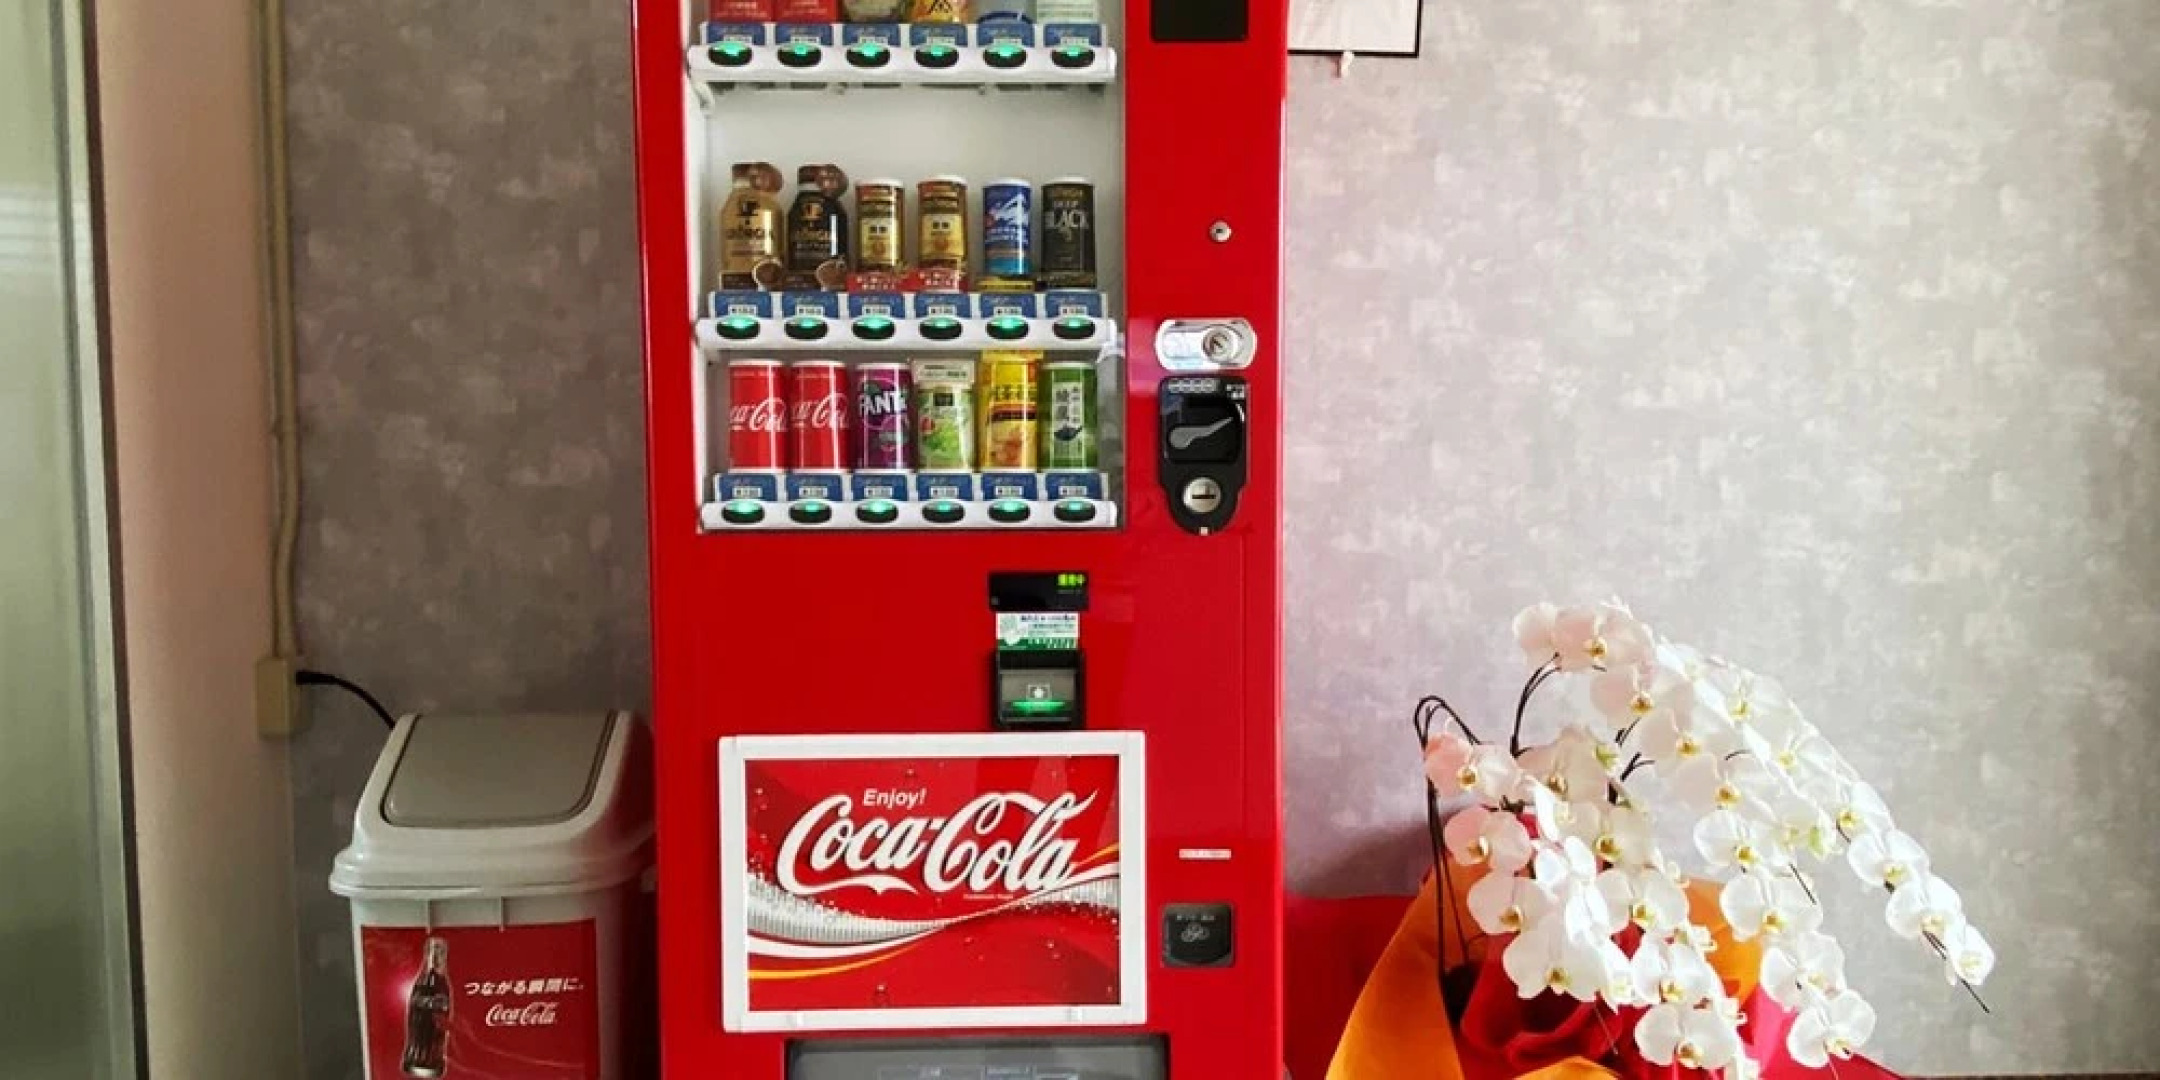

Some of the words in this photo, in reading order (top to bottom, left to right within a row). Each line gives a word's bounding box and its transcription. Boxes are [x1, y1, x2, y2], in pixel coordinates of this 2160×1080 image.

[862, 788, 927, 810] Enjoy!
[777, 788, 1099, 896] Coca-Cola
[486, 1001, 559, 1027] Coca-Cola
